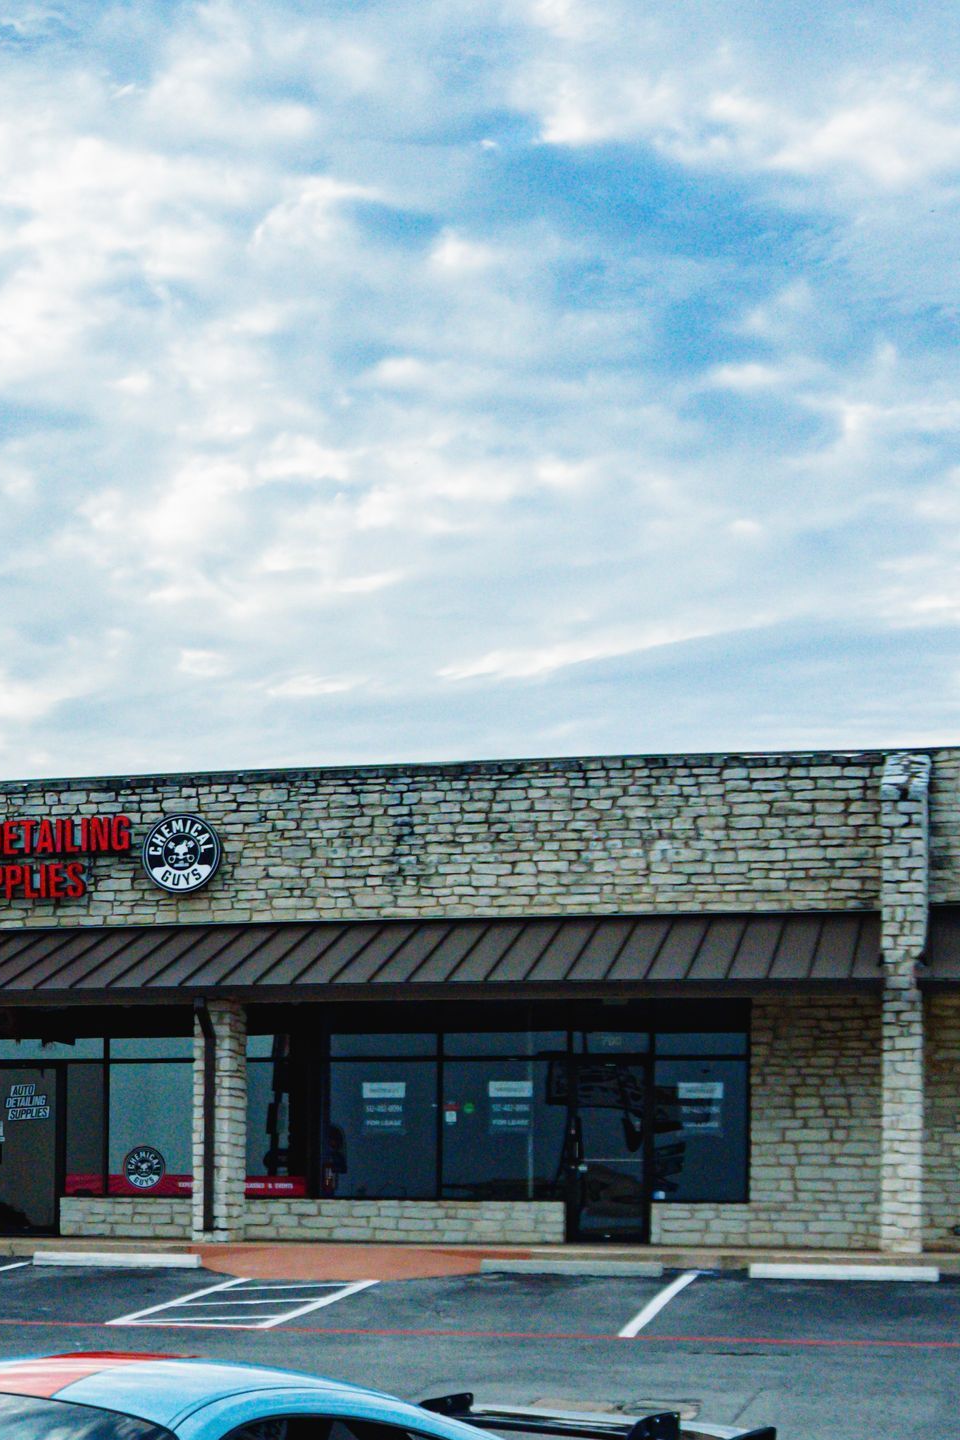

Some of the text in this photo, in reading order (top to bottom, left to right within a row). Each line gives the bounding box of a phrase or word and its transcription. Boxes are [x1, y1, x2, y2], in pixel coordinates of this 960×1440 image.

[148, 818, 214, 856] CHEMICAL
[161, 868, 202, 886] GUYS
[12, 1084, 34, 1096] AUTO
[6, 1095, 47, 1108] DETAILING
[10, 1107, 48, 1120] SUPPLIES
[127, 1151, 161, 1169] CHEMICAL
[133, 1176, 155, 1186] GUYS
